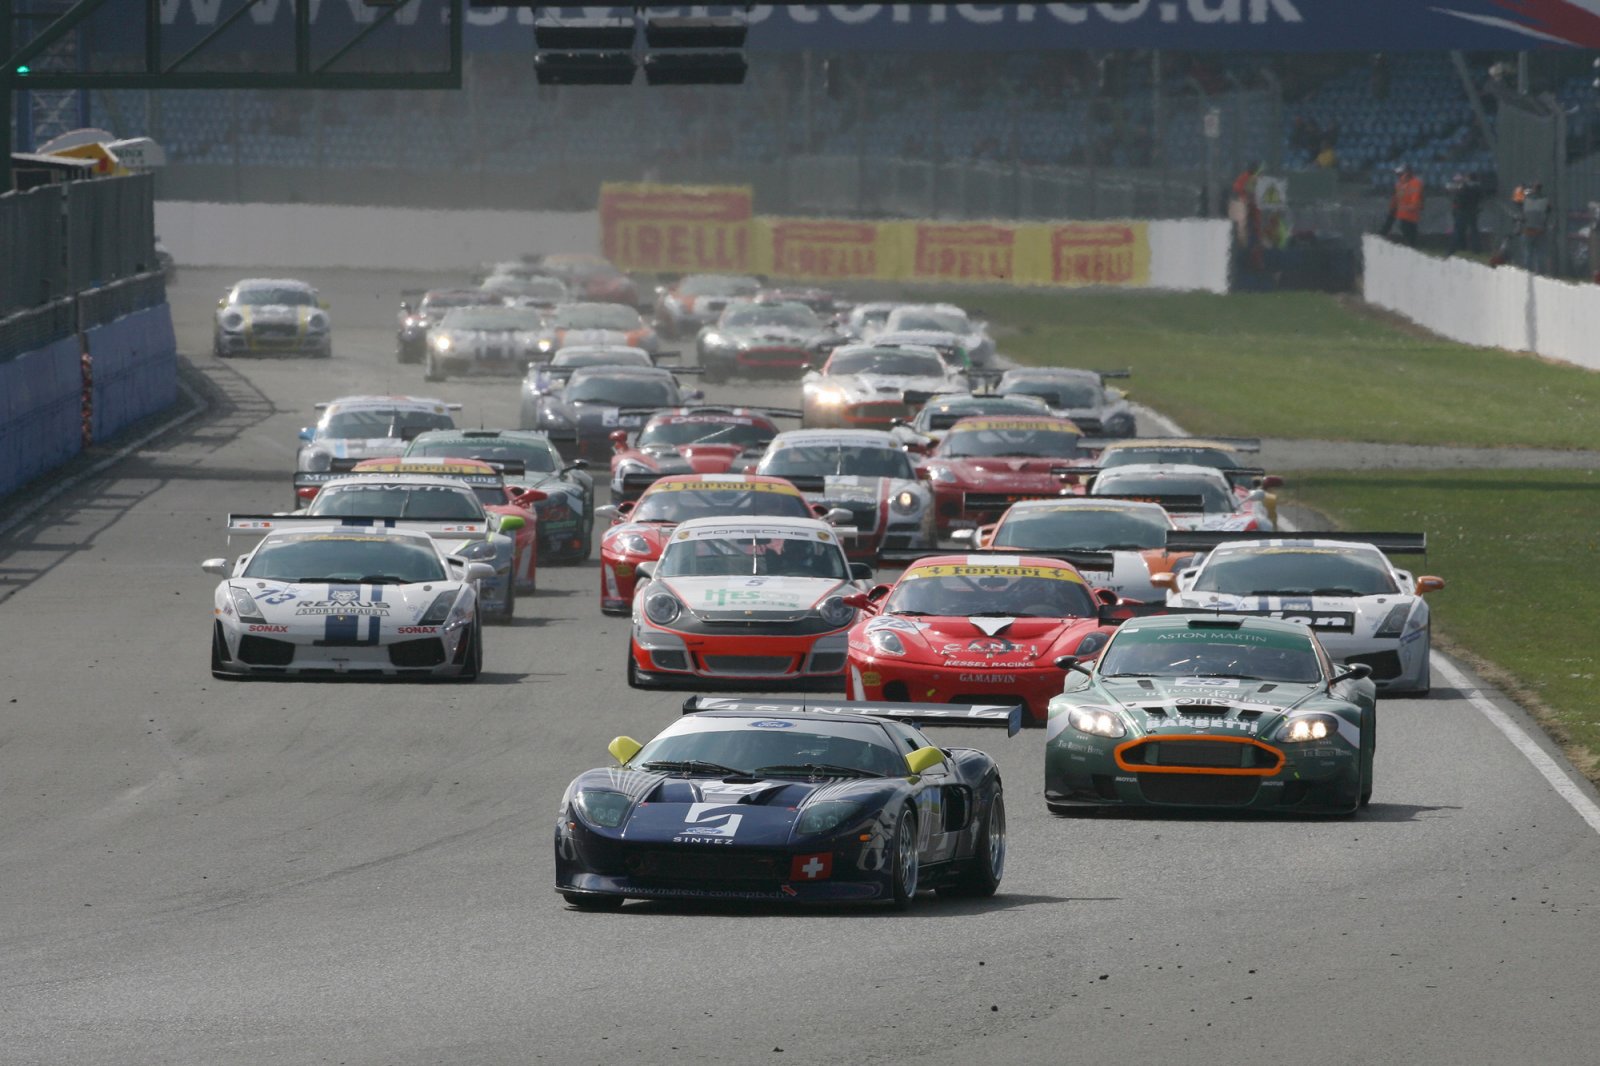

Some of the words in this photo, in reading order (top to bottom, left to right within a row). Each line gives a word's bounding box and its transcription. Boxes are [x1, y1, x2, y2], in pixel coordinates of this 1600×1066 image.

[603, 190, 752, 273] PIRELLI
[914, 224, 1015, 278] PIRELLI
[671, 416, 752, 424] DODGE
[682, 483, 757, 491] Ferrari
[697, 529, 809, 538] PORSCHE
[952, 566, 1040, 577] Ferrari
[296, 600, 391, 609] REMUS
[302, 608, 384, 616] SPORTEXHAUST
[248, 624, 289, 633] SONAX
[397, 626, 437, 634] SONAX
[1157, 632, 1207, 640] ASTON
[1211, 633, 1267, 642] MARTIN
[943, 660, 988, 668] KESSEL
[960, 673, 1016, 683] GAMARVIN
[754, 704, 951, 716] SINTEZ
[1146, 718, 1259, 733] BARBETTI
[672, 836, 734, 845] SINTEZ
[621, 886, 786, 899] www.matech-concepts.ch
